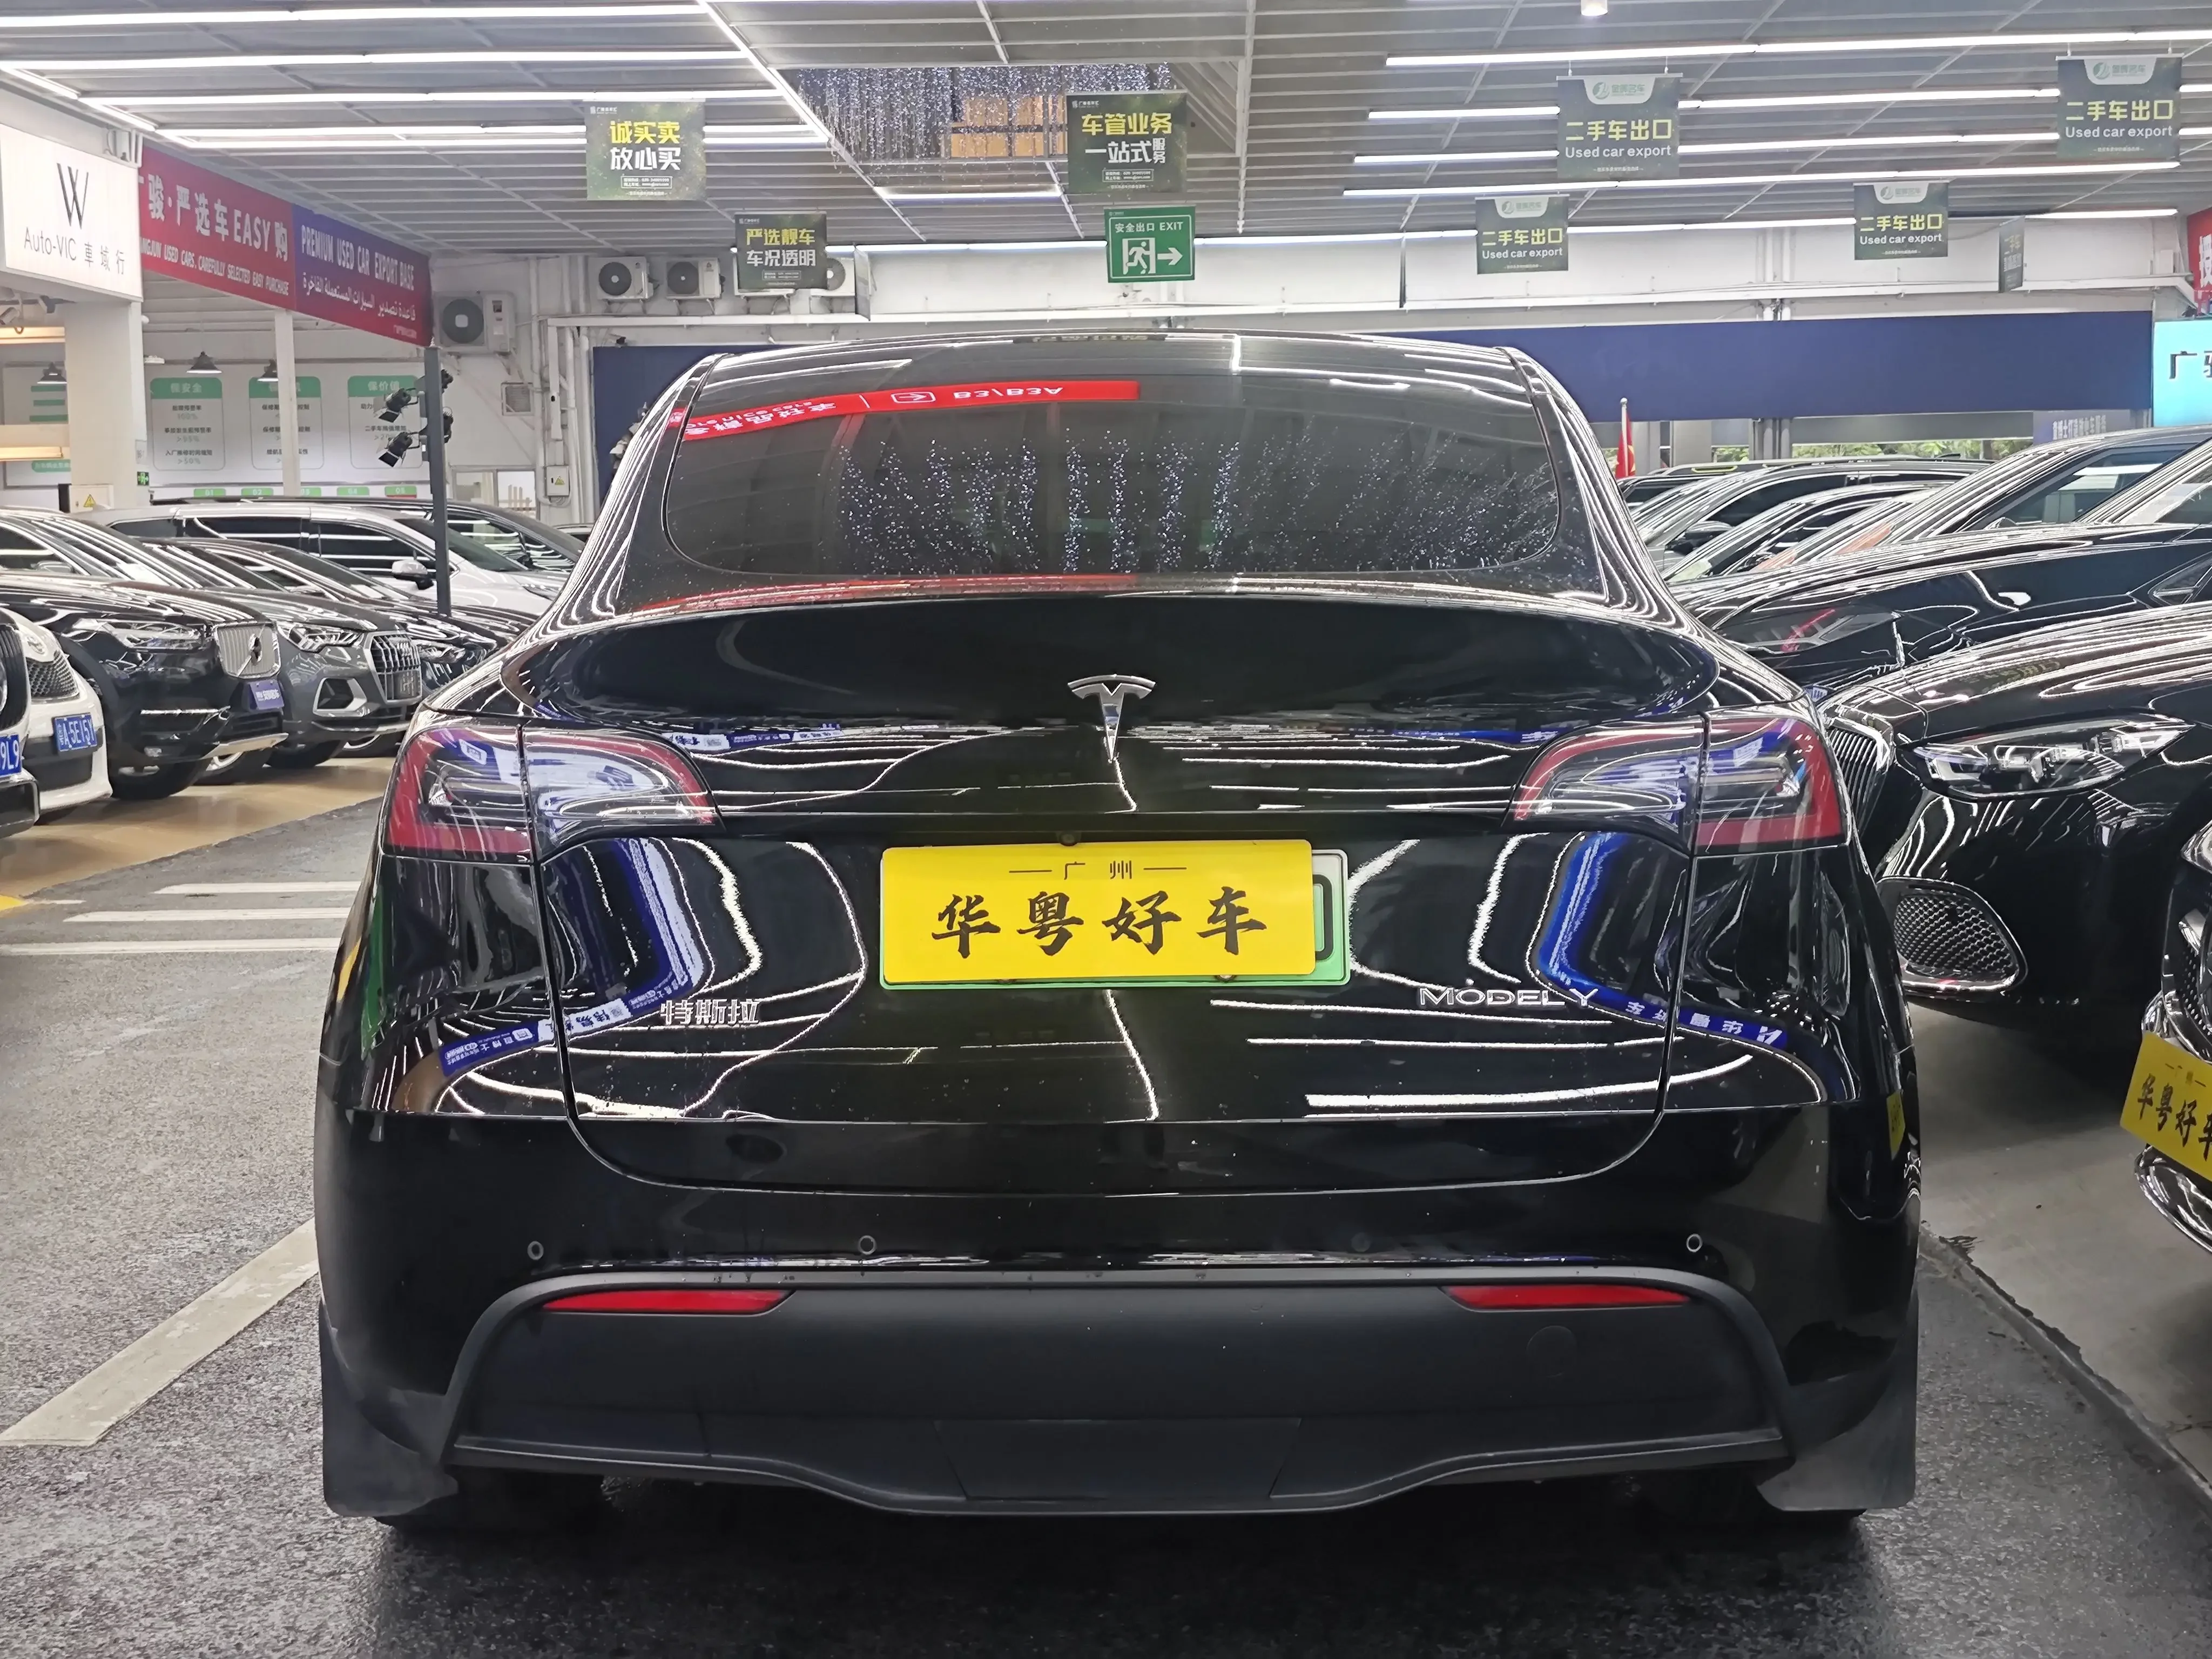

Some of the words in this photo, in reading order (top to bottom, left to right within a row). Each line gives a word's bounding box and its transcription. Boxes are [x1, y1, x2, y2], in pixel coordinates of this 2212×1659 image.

[2066, 99, 2174, 121] 二手车出口
[610, 120, 680, 144] 诚实卖
[1081, 112, 1172, 136] 车管业务
[1566, 119, 1672, 141] 二手车出口
[2066, 126, 2100, 138] Used
[2103, 127, 2125, 137] car
[2128, 125, 2172, 139] export
[610, 147, 681, 171] 放心买
[1566, 146, 1600, 158] Used
[1603, 148, 1624, 157] car
[1627, 145, 1671, 158] export
[1115, 222, 1155, 233] 安全出口
[1159, 221, 1184, 231] EXIT
[1859, 213, 1943, 232] 二手车出口
[24, 227, 77, 261] Auto-VIC
[746, 228, 815, 245] 严选靓车
[1482, 228, 1563, 246] 二手车出口
[1860, 235, 1887, 245] Used
[1889, 236, 1906, 245] car
[1908, 233, 1942, 246] export
[301, 225, 334, 264] PREMIUM
[337, 238, 355, 270] USED
[358, 246, 370, 276] CAR
[375, 252, 398, 285] EXPORT
[400, 261, 414, 291] BASE
[746, 249, 816, 267] 车况透明
[1482, 249, 1509, 259] Used
[1529, 247, 1563, 259] export
[164, 244, 179, 264] USED
[198, 255, 226, 276] CAREFULLY
[227, 264, 251, 285] SELECTED
[253, 272, 264, 289] EASY
[266, 275, 289, 295] PURCHASE
[1063, 859, 1133, 881] 广州
[932, 886, 1267, 959] 华粤好车
[1419, 987, 1566, 1007] MODEL
[1570, 988, 1599, 1007] Y
[659, 999, 760, 1025] 特斯拉
